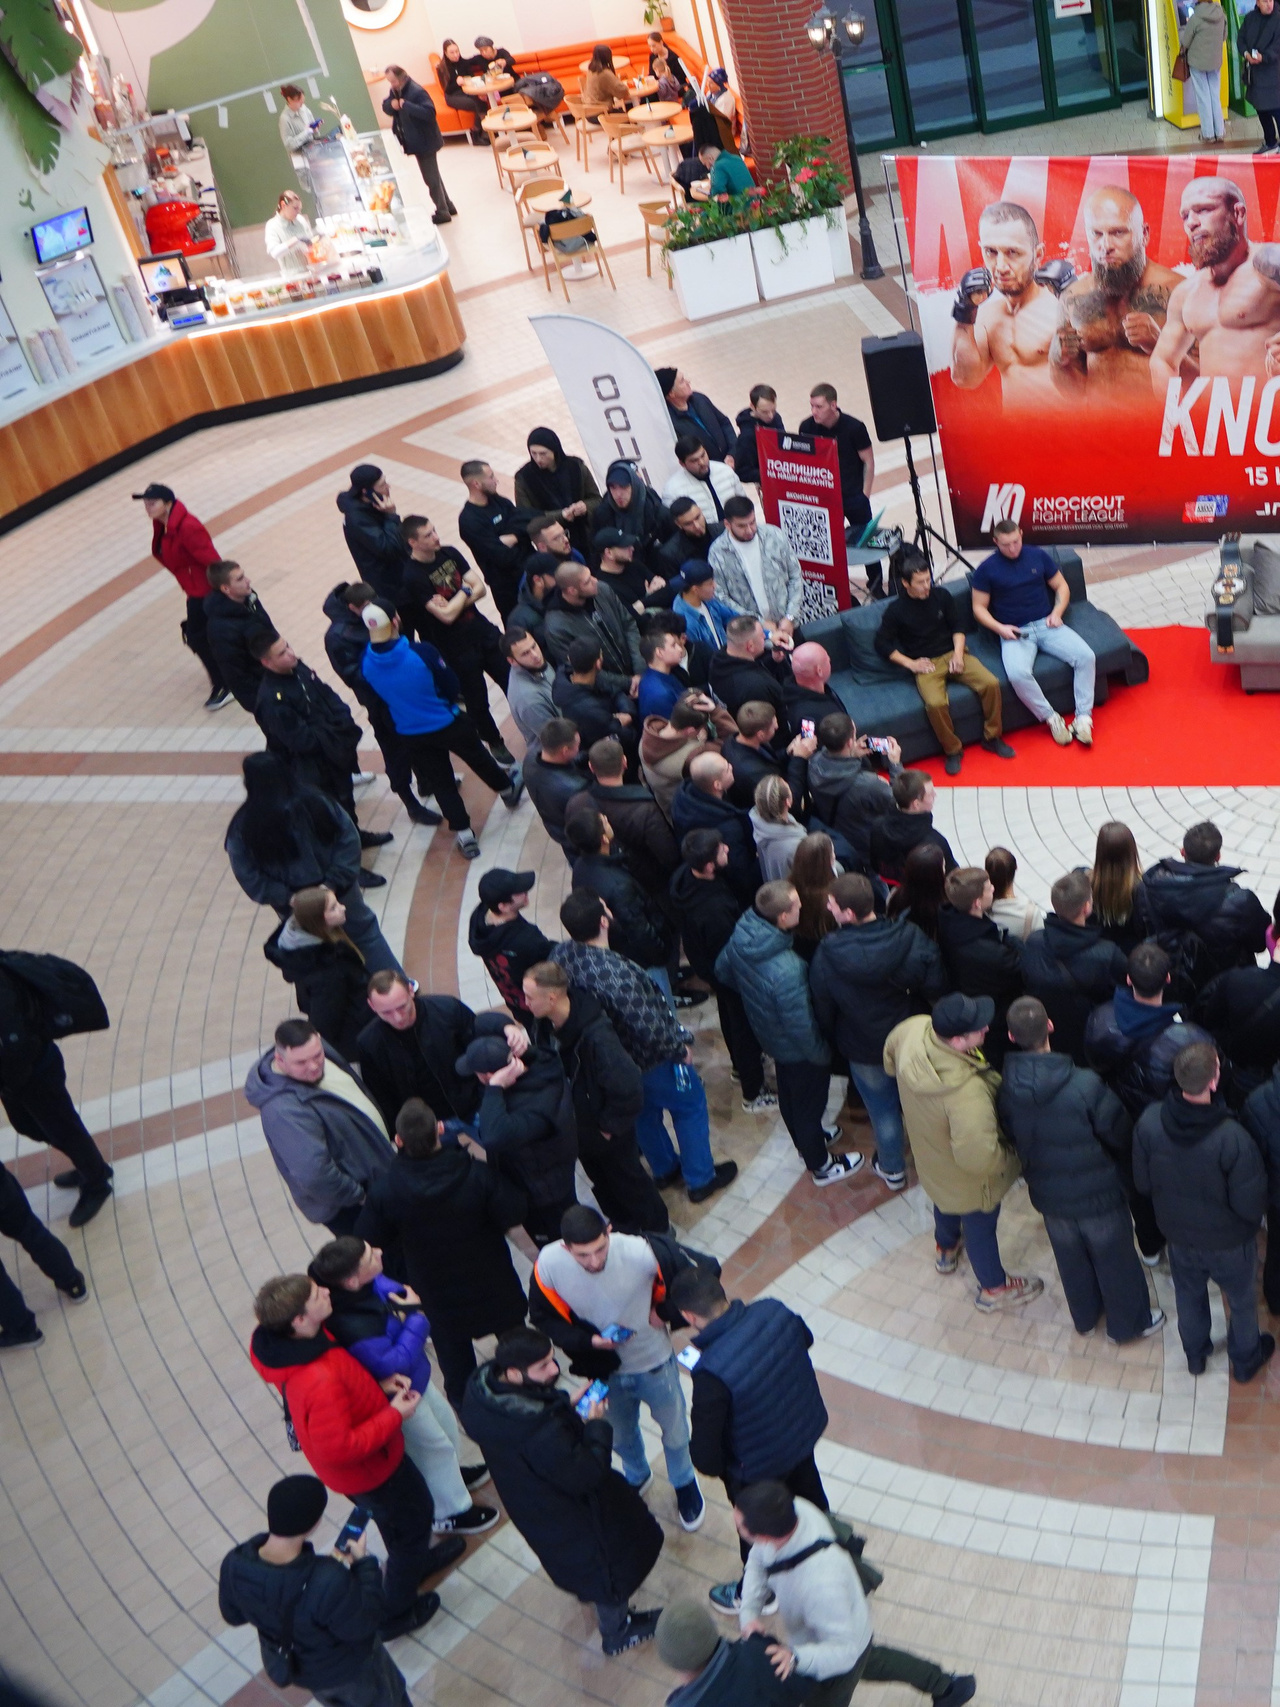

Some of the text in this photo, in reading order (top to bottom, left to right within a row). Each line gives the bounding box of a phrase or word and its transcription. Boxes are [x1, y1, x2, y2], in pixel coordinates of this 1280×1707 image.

[767, 458, 834, 481] ПОДПИШИСЬ
[1244, 466, 1269, 486] 15
[1033, 495, 1125, 512] KNOCKOUT
[1032, 509, 1125, 523] FIGHT LEAGUE
